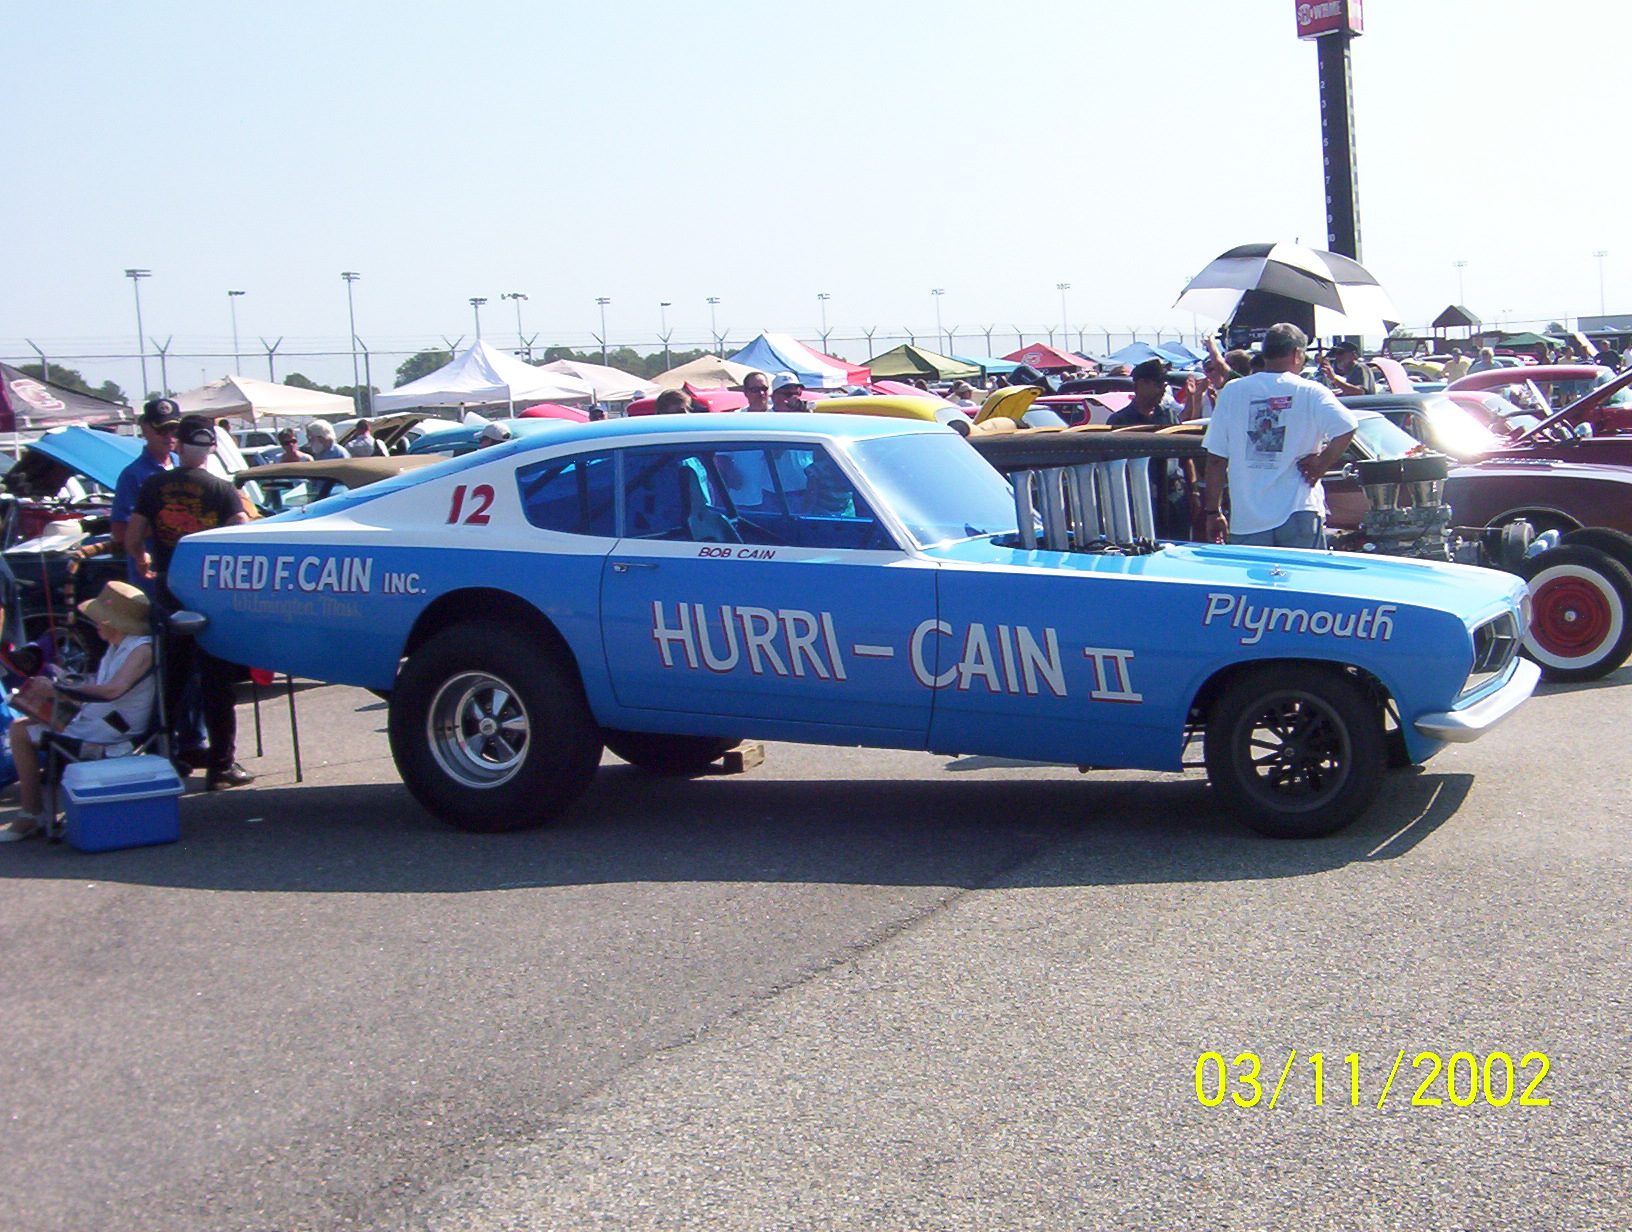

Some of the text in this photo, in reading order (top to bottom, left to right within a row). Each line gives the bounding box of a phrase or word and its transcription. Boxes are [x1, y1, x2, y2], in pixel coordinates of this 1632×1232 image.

[446, 484, 495, 526] 12
[698, 547, 776, 560] BOB CAIN
[202, 555, 427, 595] FRED F. CAIN INC.
[1202, 593, 1397, 646] Plymouth
[909, 619, 1067, 698] CAIN
[1083, 647, 1143, 704] II
